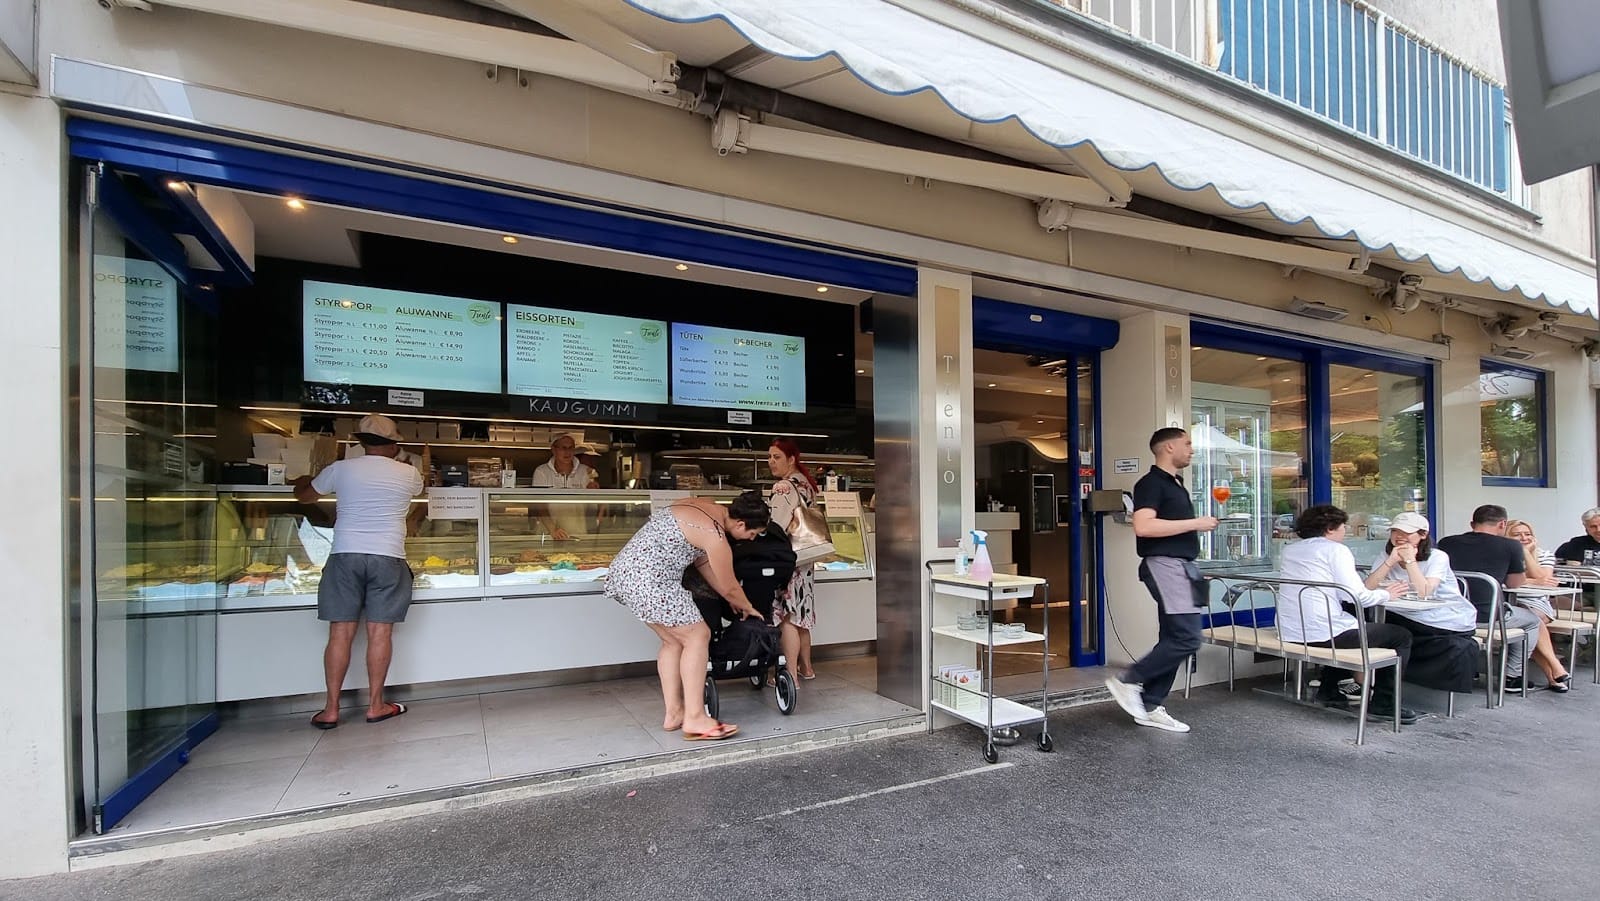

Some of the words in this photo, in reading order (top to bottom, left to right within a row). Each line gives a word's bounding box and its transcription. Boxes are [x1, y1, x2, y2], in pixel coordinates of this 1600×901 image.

[315, 298, 372, 310] STYROPOR
[396, 306, 453, 319] ALUWANNE
[315, 318, 343, 326] Styropor
[516, 312, 575, 326] EISSORTEN
[315, 332, 343, 340] Styropor
[315, 358, 343, 366] Styropor
[529, 399, 636, 418] KAUGUMMI
